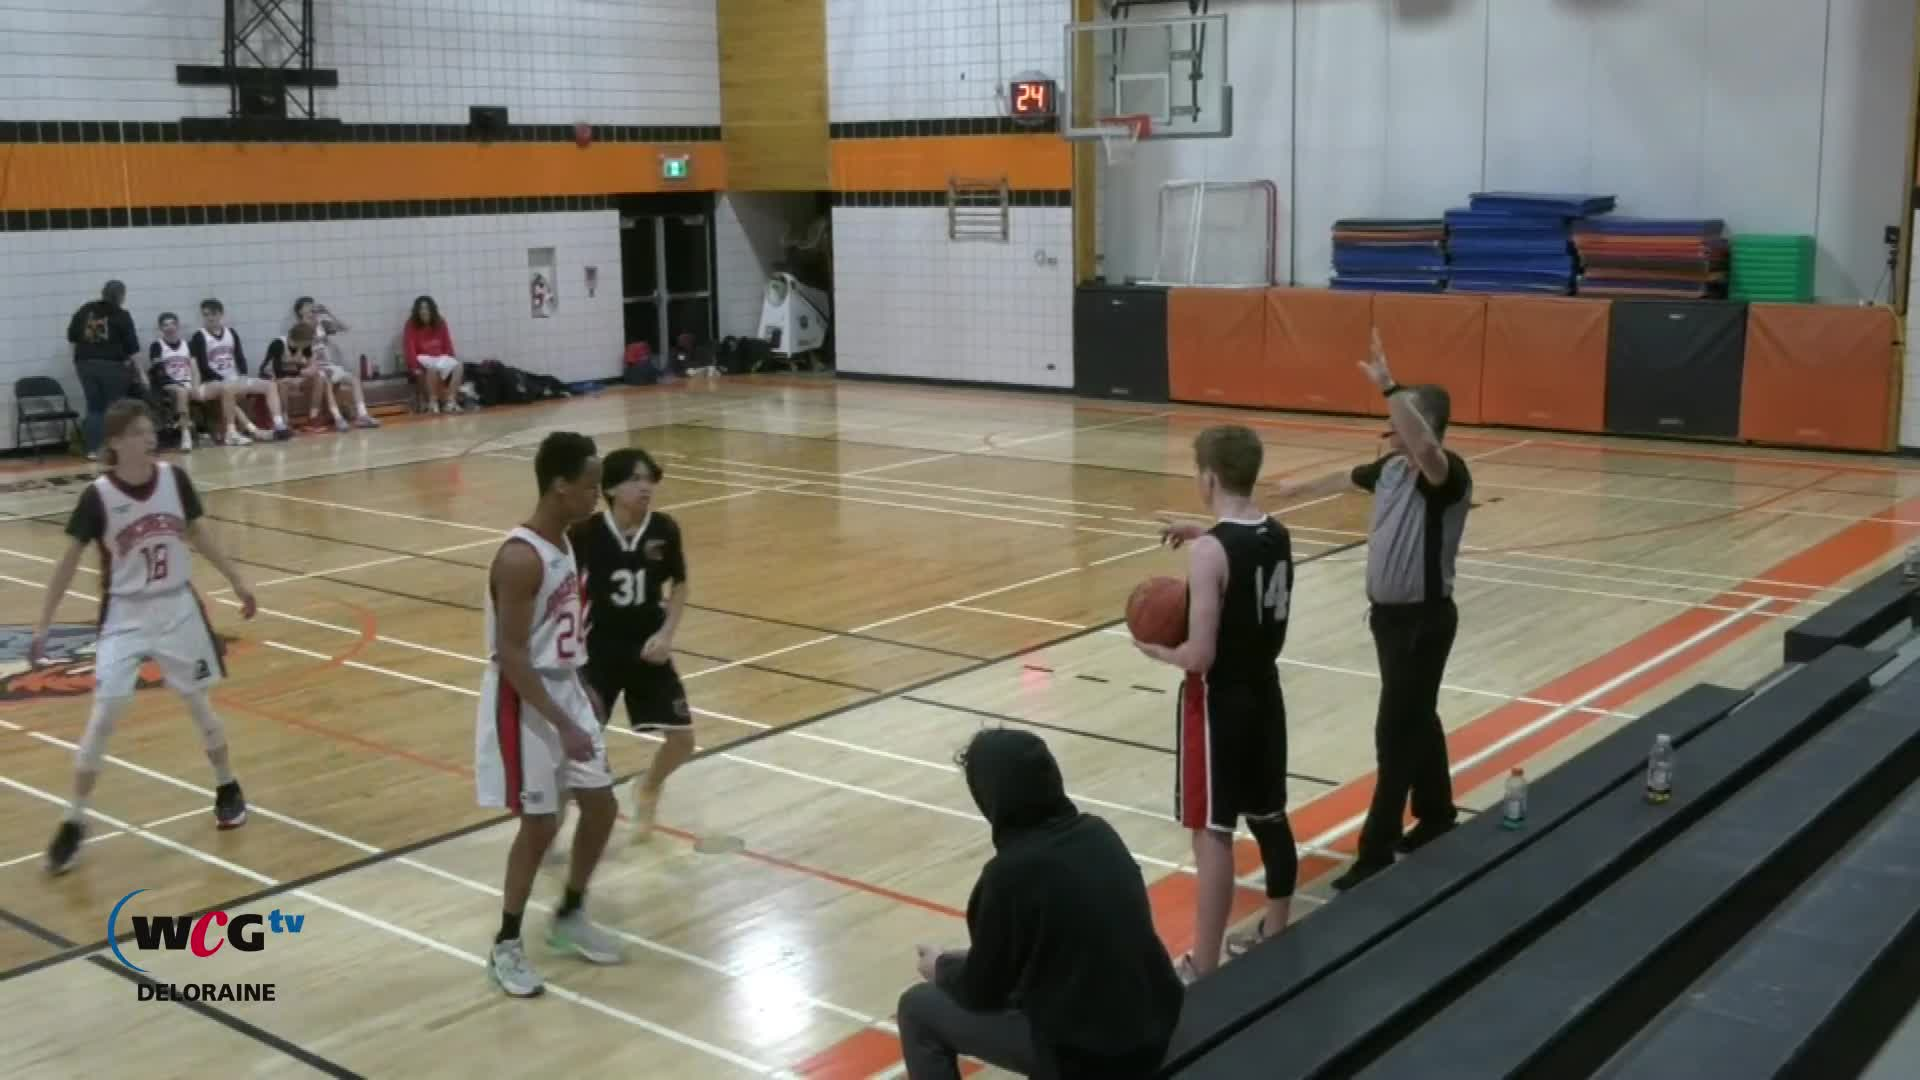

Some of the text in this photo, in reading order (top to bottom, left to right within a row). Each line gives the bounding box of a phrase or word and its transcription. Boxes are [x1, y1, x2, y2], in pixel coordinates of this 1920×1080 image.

[1017, 84, 1043, 110] 24
[610, 568, 646, 607] 31
[1255, 560, 1288, 625] 14
